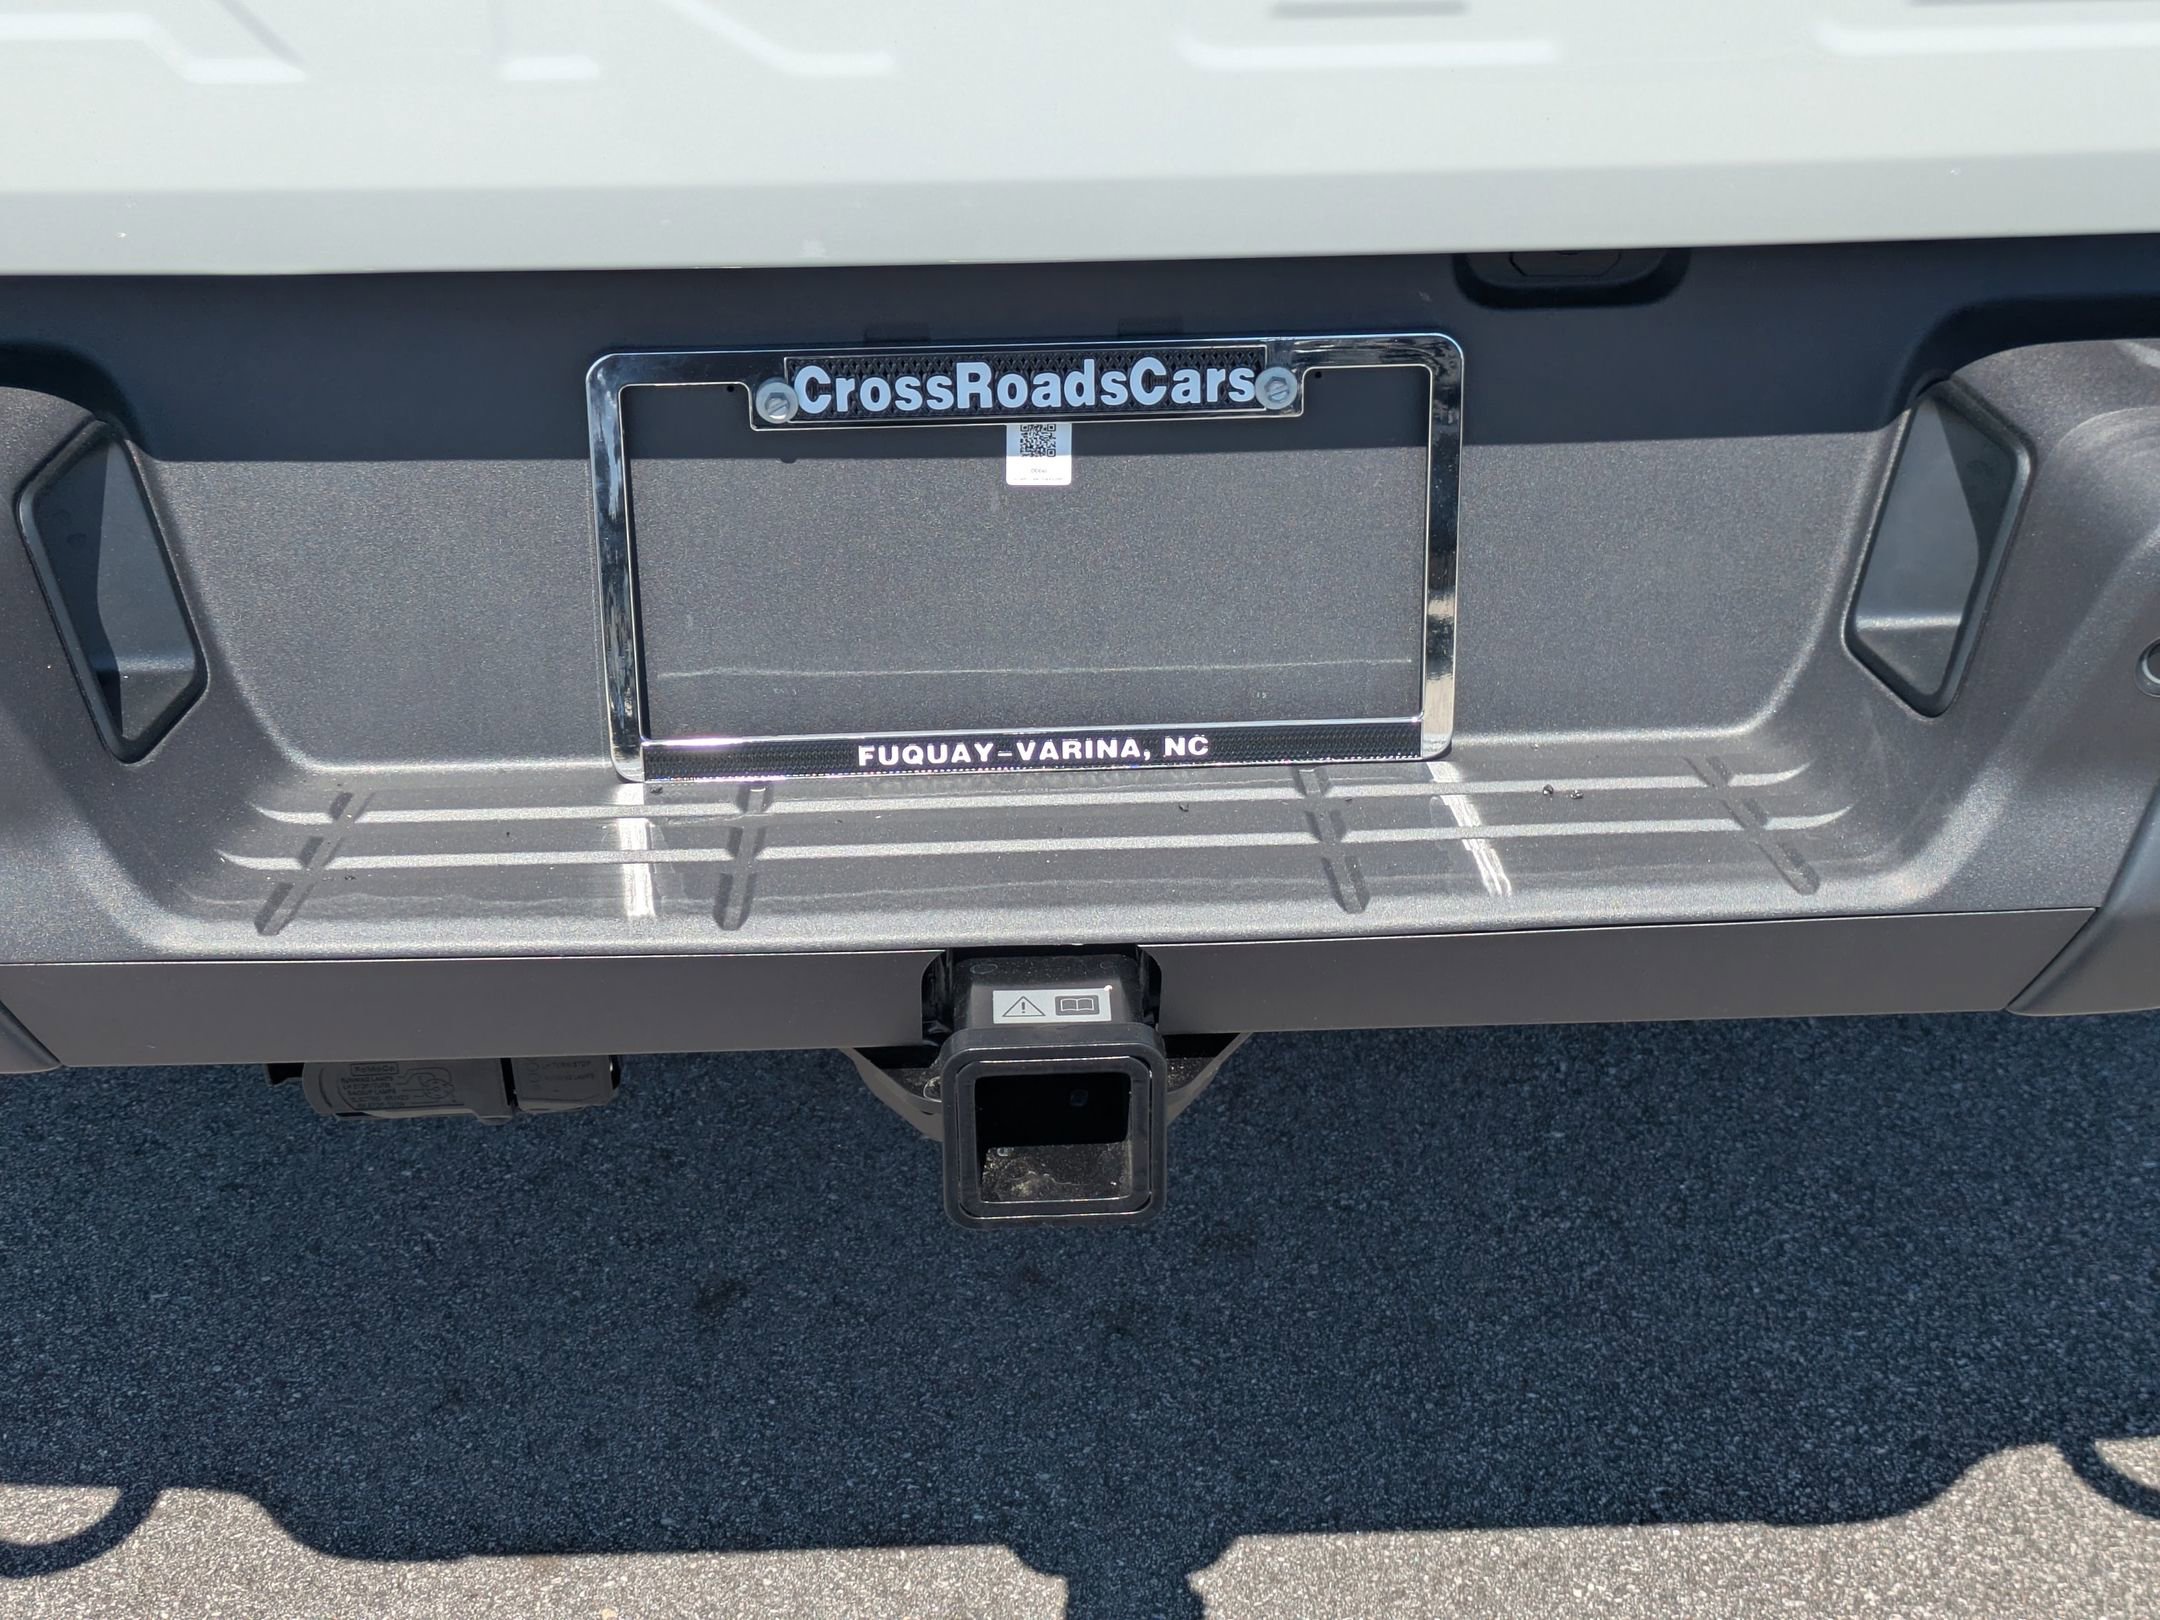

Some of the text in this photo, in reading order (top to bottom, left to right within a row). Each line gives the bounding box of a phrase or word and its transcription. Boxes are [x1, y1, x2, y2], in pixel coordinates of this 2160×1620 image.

[794, 356, 1255, 414] CrossRoadsCars
[858, 735, 1209, 766] FUQUAY-VARINA, NC
